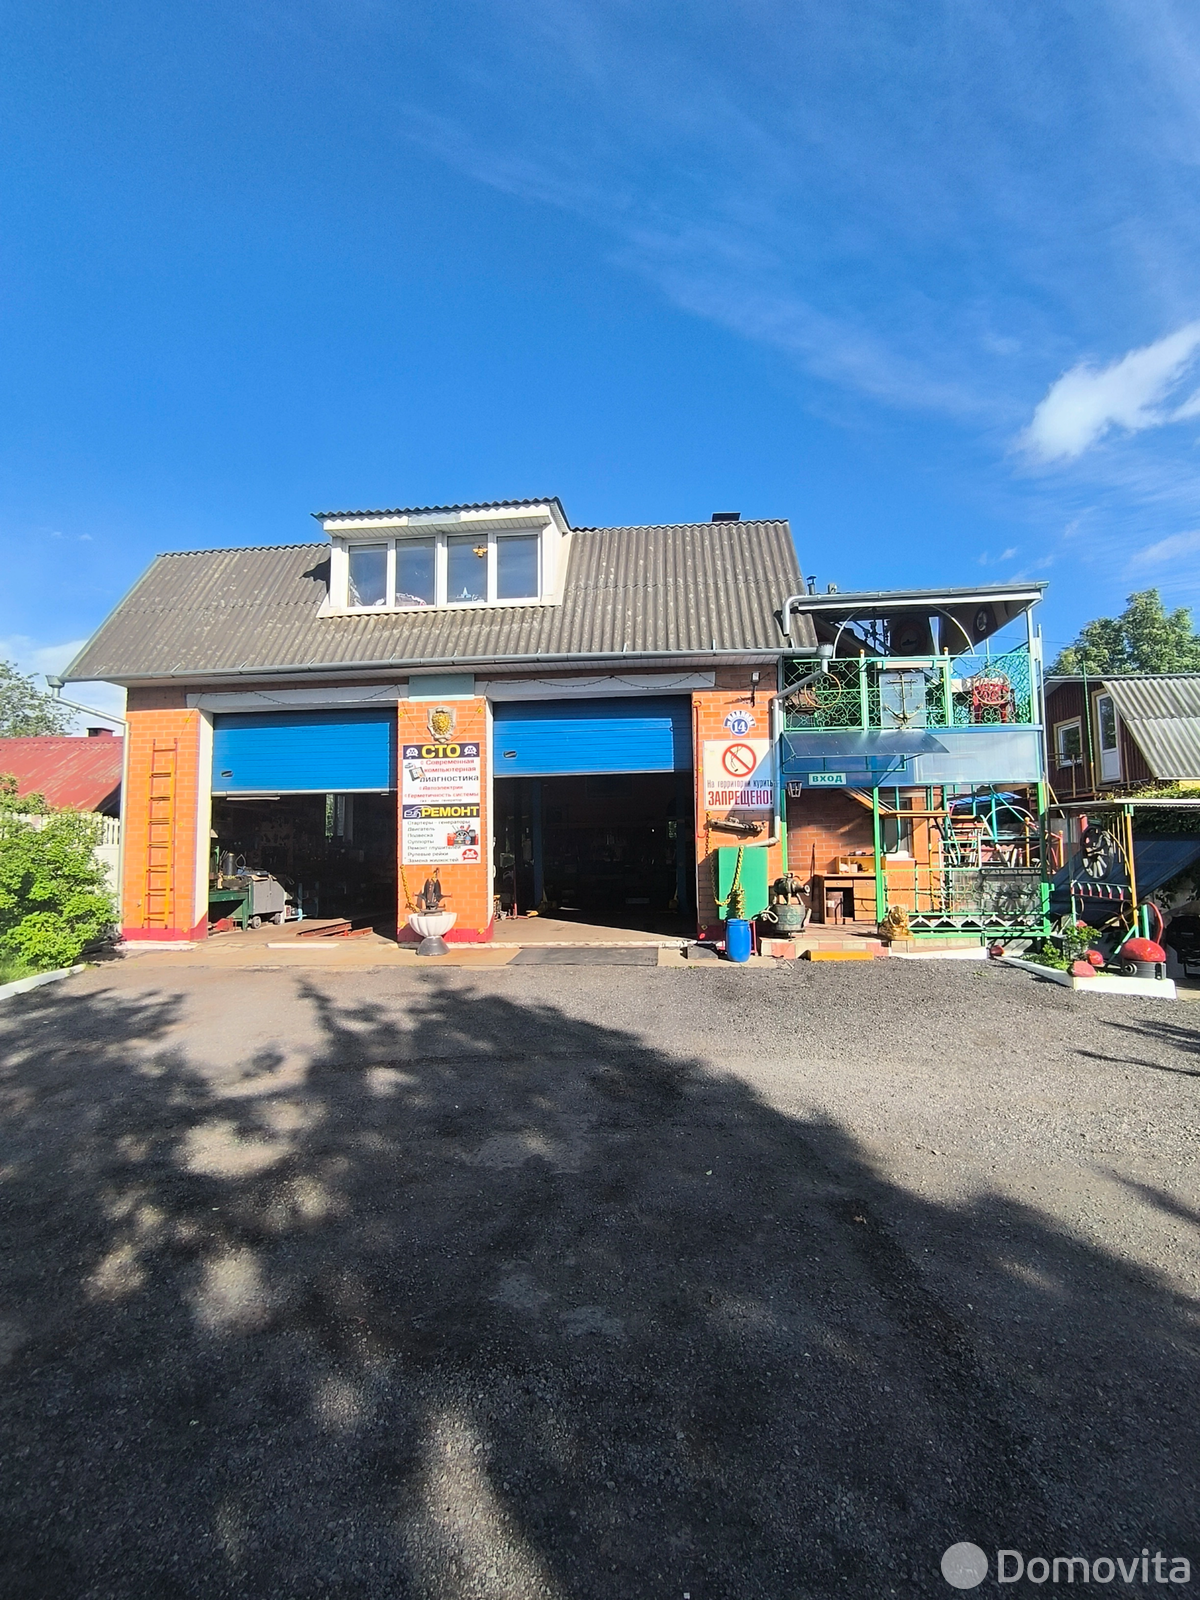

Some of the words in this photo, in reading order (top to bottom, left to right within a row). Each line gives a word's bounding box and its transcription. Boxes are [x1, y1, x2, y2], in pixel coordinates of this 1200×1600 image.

[734, 720, 746, 732] 14
[422, 744, 460, 758] СТО
[718, 780, 750, 788] территории
[753, 780, 773, 788] курить
[812, 775, 842, 783] ВХОД
[708, 790, 773, 807] ЗАПРЕЩЕНО!
[422, 806, 480, 817] РЕМОНТ
